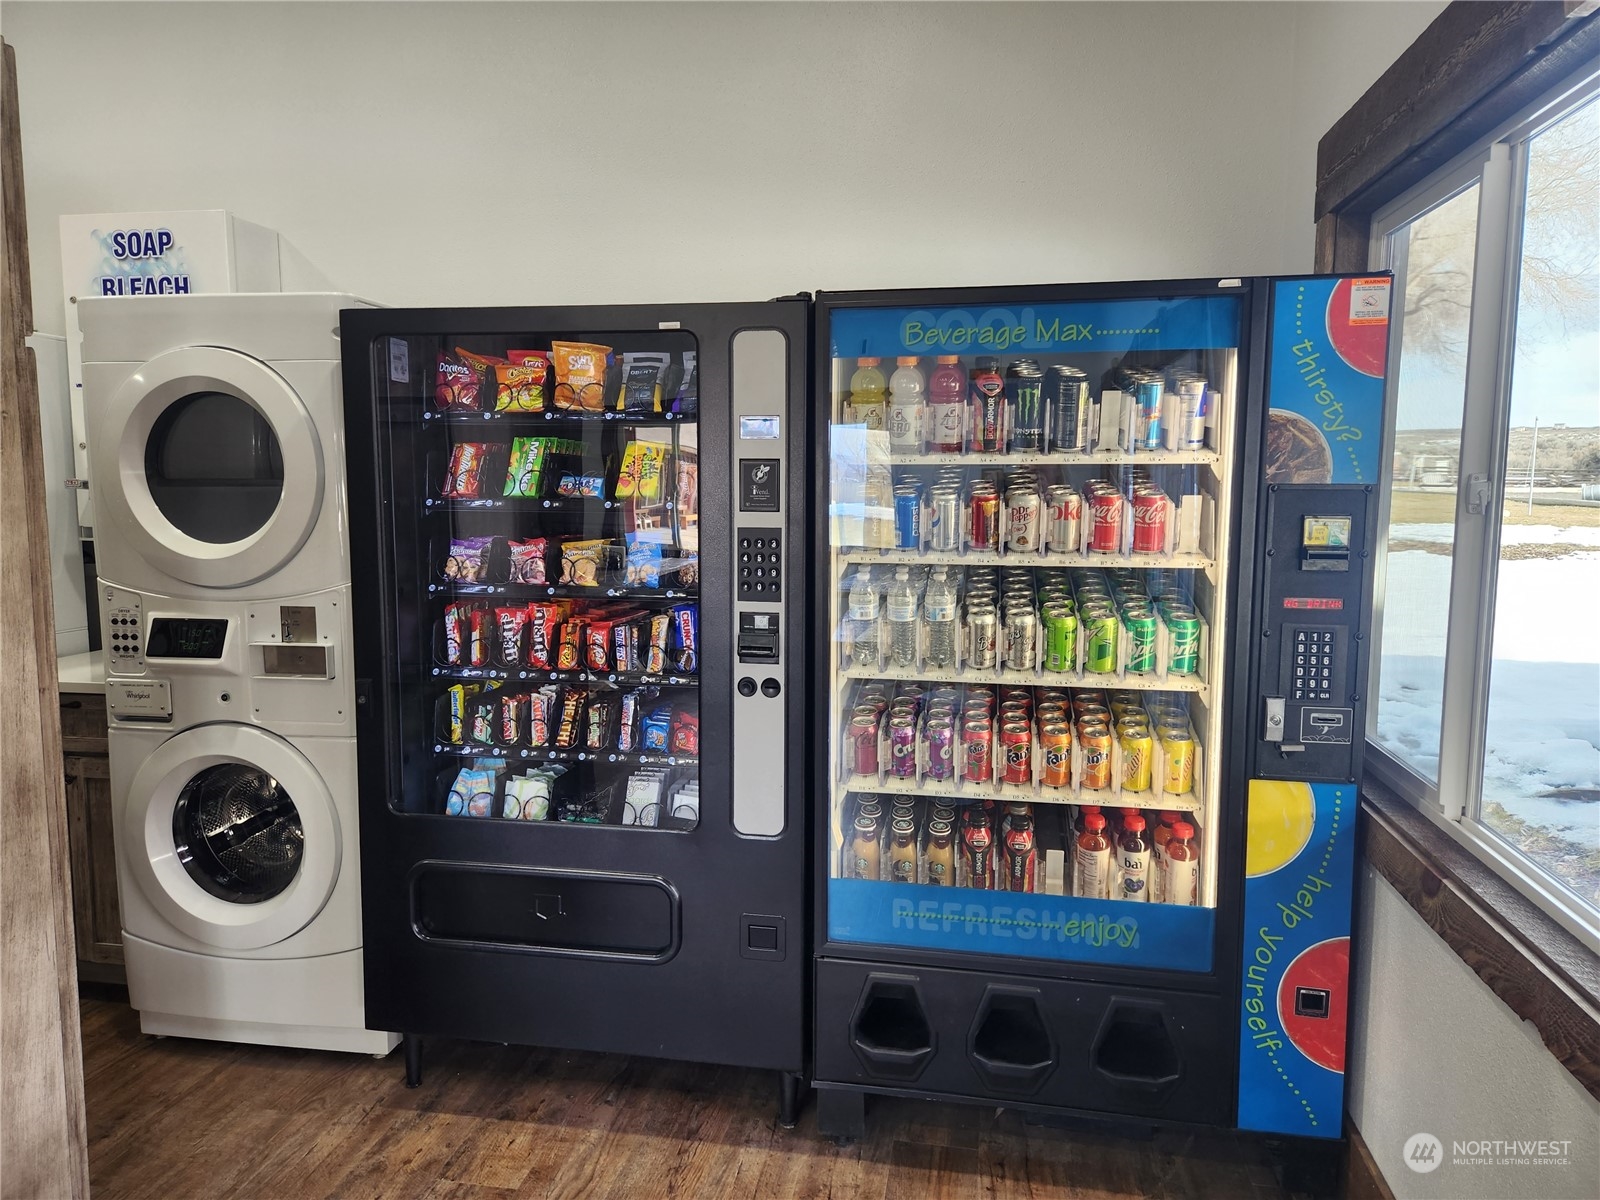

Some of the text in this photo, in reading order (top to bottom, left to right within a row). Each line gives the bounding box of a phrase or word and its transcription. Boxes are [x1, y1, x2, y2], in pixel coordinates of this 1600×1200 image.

[113, 231, 173, 258] SOAP
[102, 276, 191, 296] BLEACH
[905, 318, 1093, 349] Beverage Max
[439, 362, 470, 375] Doritos
[1292, 338, 1362, 441] thirsty?
[526, 441, 540, 471] Mike
[912, 501, 920, 537] pepsi
[1011, 506, 1038, 523] Dr Pepper
[1051, 501, 1081, 521] oke
[126, 692, 151, 701] Whirlpool
[556, 700, 577, 745] HEATH
[893, 743, 916, 758] Cru
[1006, 746, 1031, 764] Fant
[1046, 750, 1071, 766] Fant
[1086, 752, 1109, 765] anta
[974, 852, 984, 888] BODARMOR
[1013, 855, 1022, 891] BODARMOR
[1124, 856, 1142, 869] bai
[892, 898, 1140, 949] REFRESHING
[1063, 916, 1138, 947] enjoy
[1246, 875, 1332, 1051] help yourself
